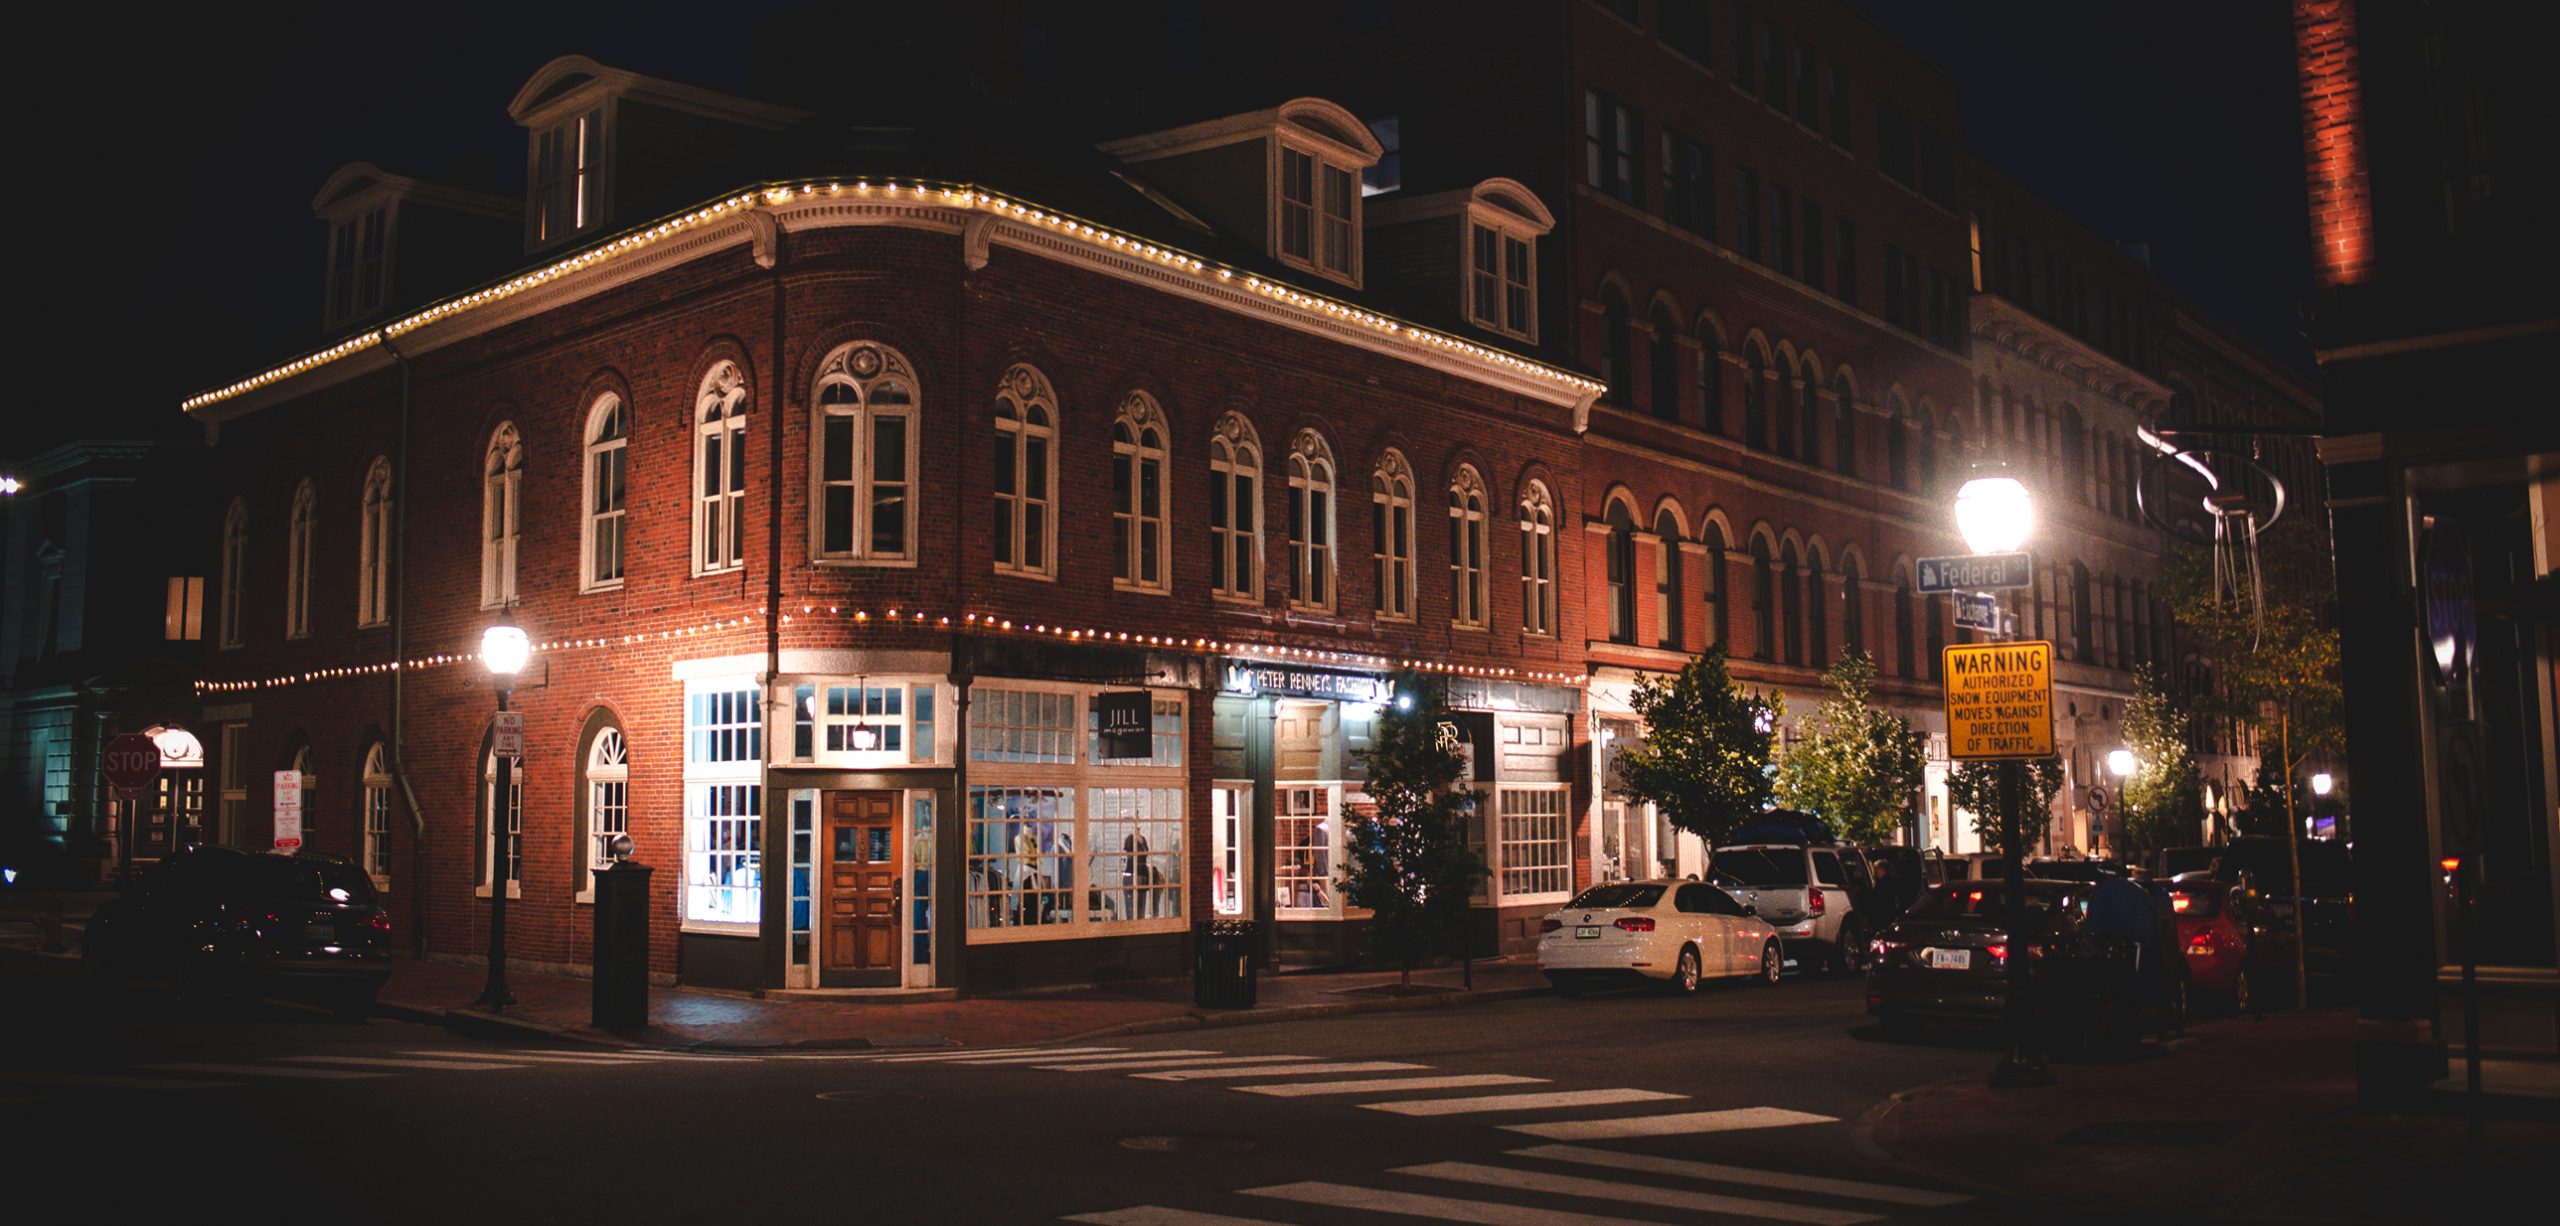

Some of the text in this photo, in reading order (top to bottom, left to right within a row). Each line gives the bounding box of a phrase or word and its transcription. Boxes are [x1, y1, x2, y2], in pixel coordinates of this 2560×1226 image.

[1940, 560, 2007, 587] Federal
[2431, 571, 2473, 631] STOP
[1953, 650, 2042, 674] WARNING
[1256, 671, 1285, 689] PETER
[1962, 674, 2034, 689] AUTHORIZED
[1950, 689, 2048, 705] SNOW EQUIPMENT
[503, 716, 516, 725] NO
[1110, 708, 1139, 728] JILL
[1955, 705, 2044, 721] MOVES AGAINST
[1970, 721, 2029, 736] DIRECTION
[1967, 736, 2034, 752] OF TRAFFIC
[106, 751, 157, 771] STOP
